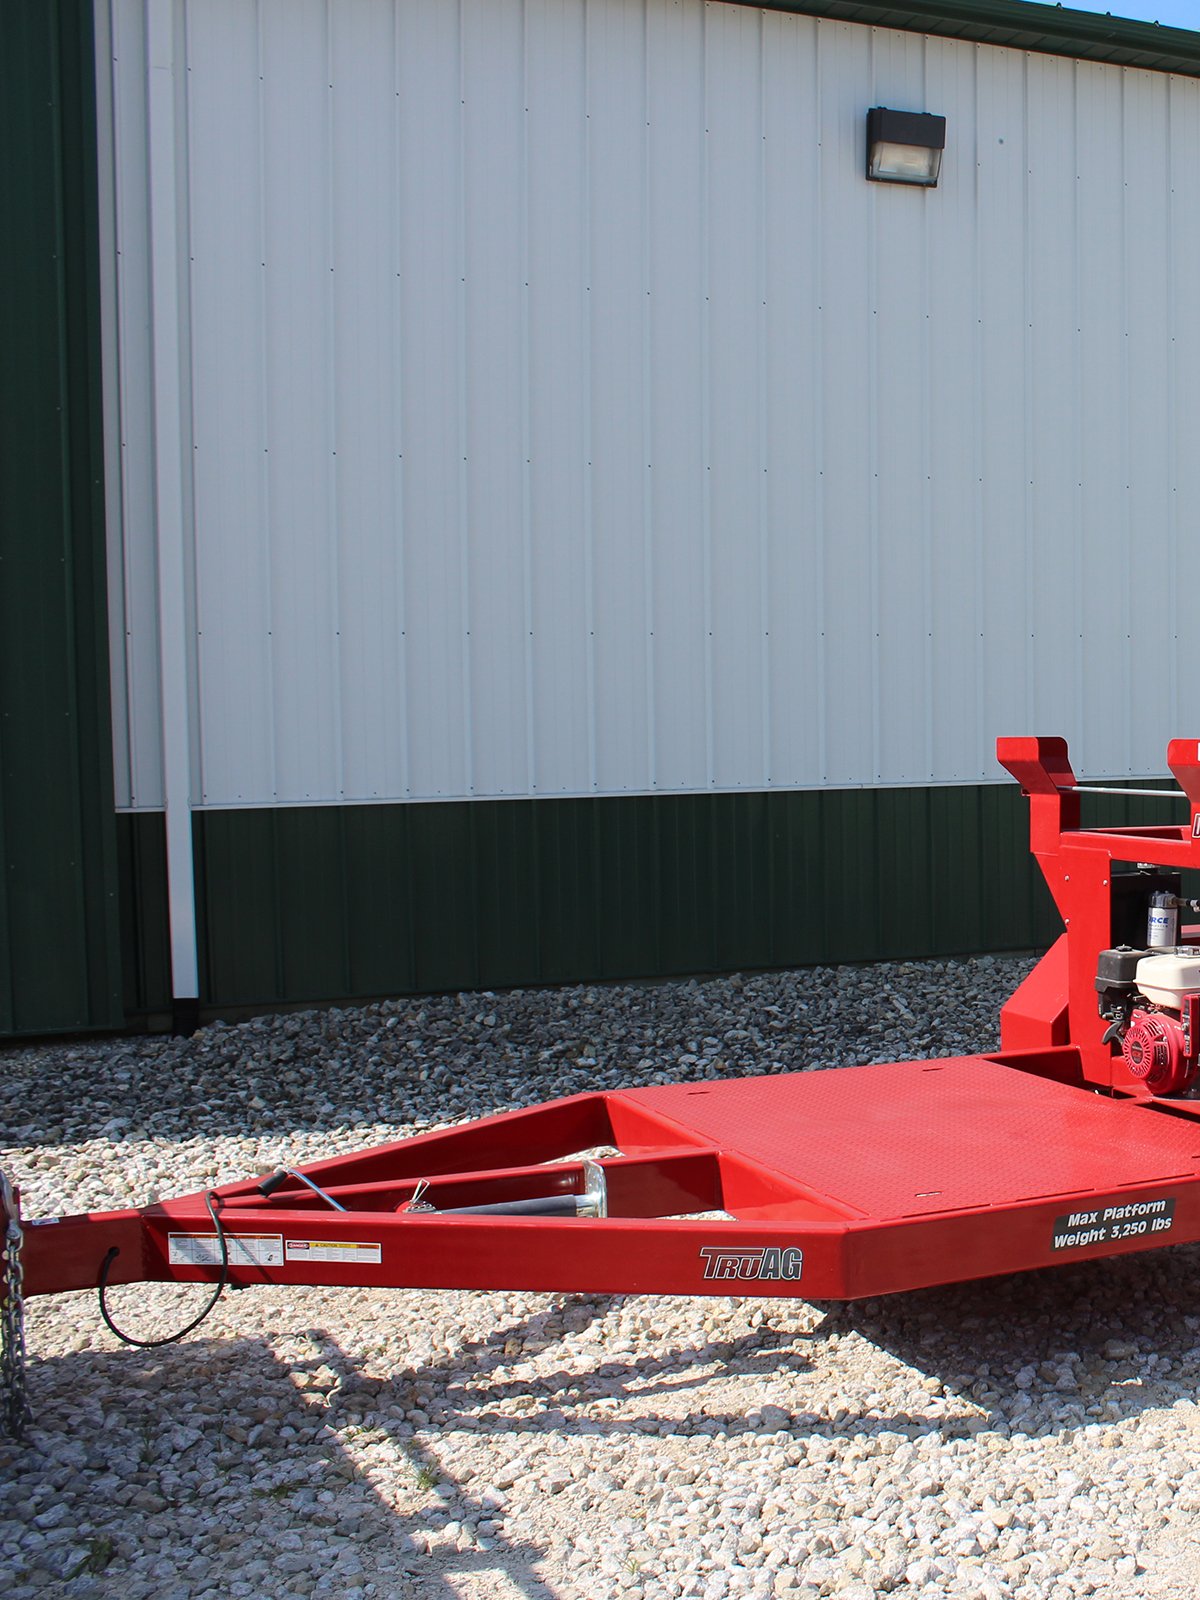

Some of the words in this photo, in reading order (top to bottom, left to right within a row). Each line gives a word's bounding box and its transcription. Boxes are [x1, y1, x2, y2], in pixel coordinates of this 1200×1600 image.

[1067, 1211, 1099, 1228] Max
[1102, 1199, 1166, 1222] Platform
[1053, 1227, 1107, 1249] Weight
[1110, 1220, 1147, 1240] 3,250
[1151, 1216, 1172, 1232] lbs
